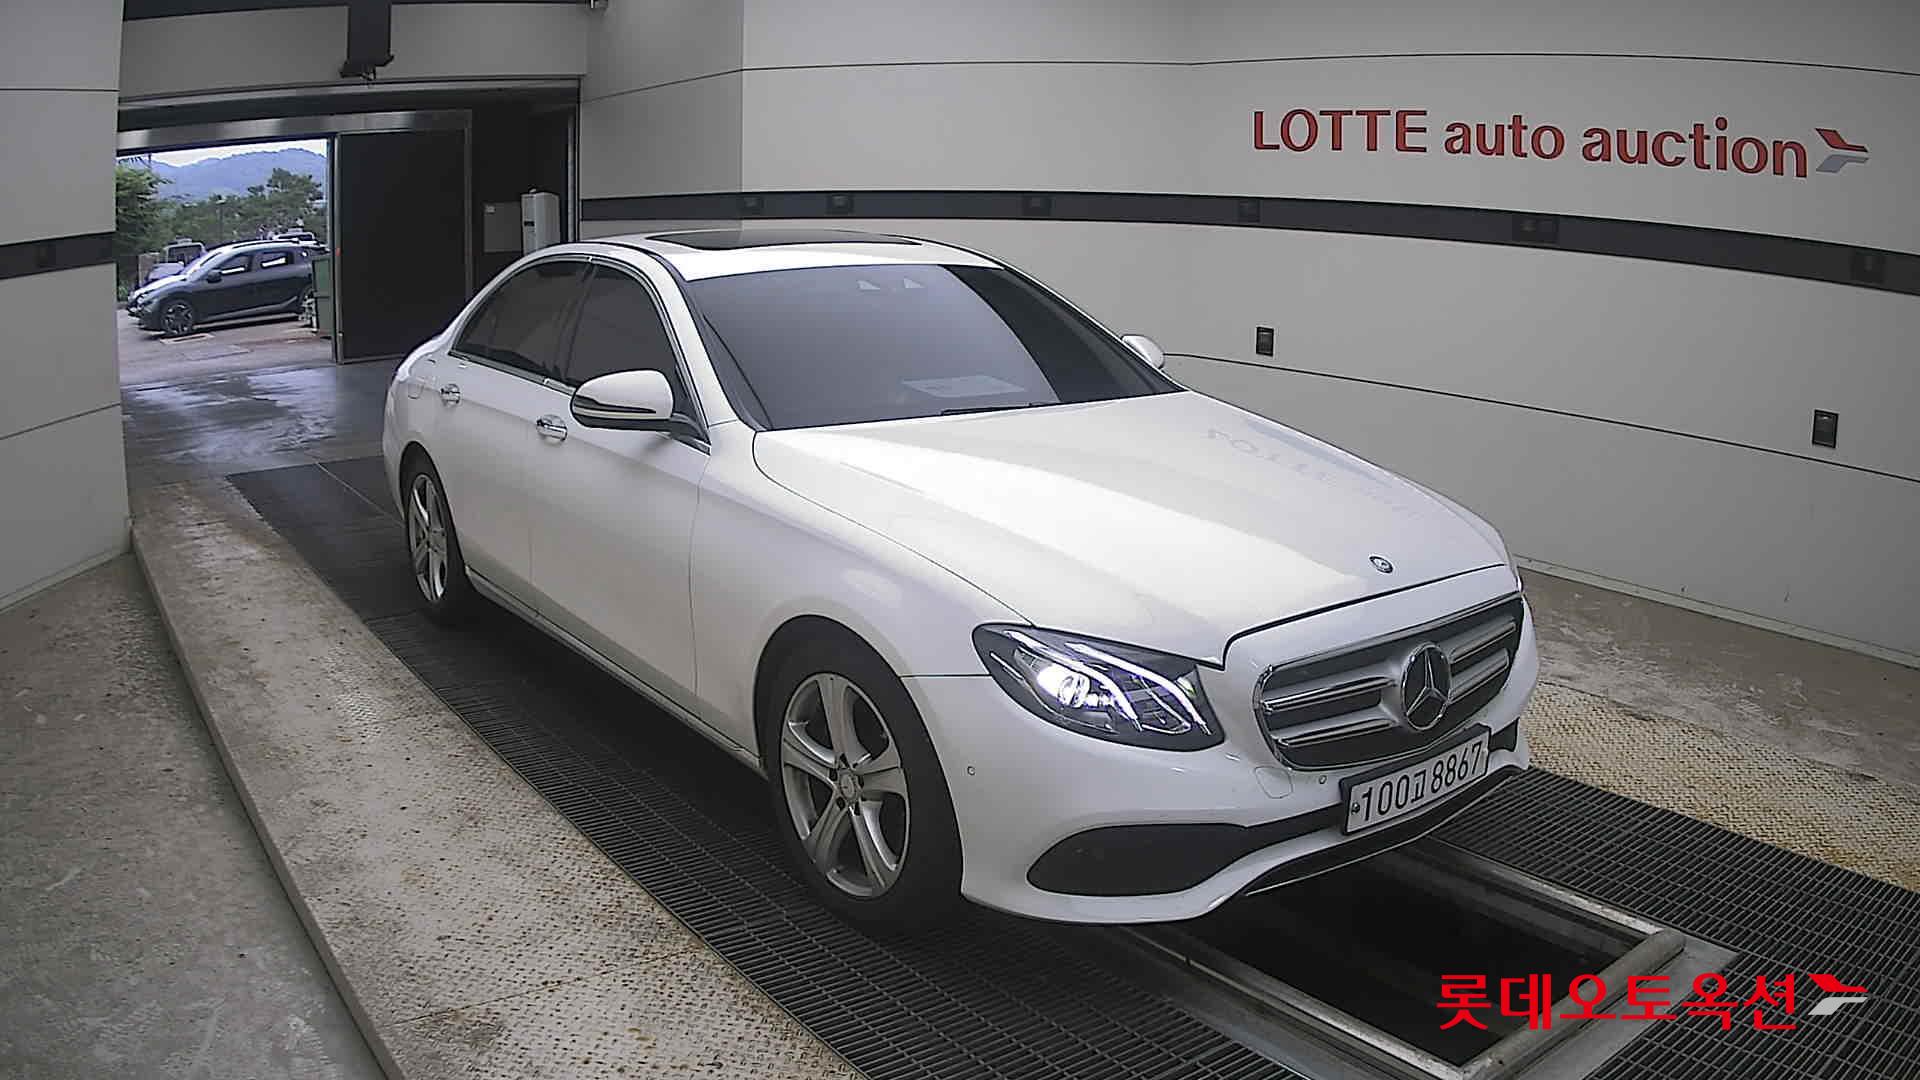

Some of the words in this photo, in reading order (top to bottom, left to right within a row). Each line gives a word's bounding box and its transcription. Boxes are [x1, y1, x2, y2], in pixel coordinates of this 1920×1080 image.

[1252, 109, 1428, 153] LOTTE
[1444, 113, 1566, 160] auto
[1581, 116, 1807, 179] auction
